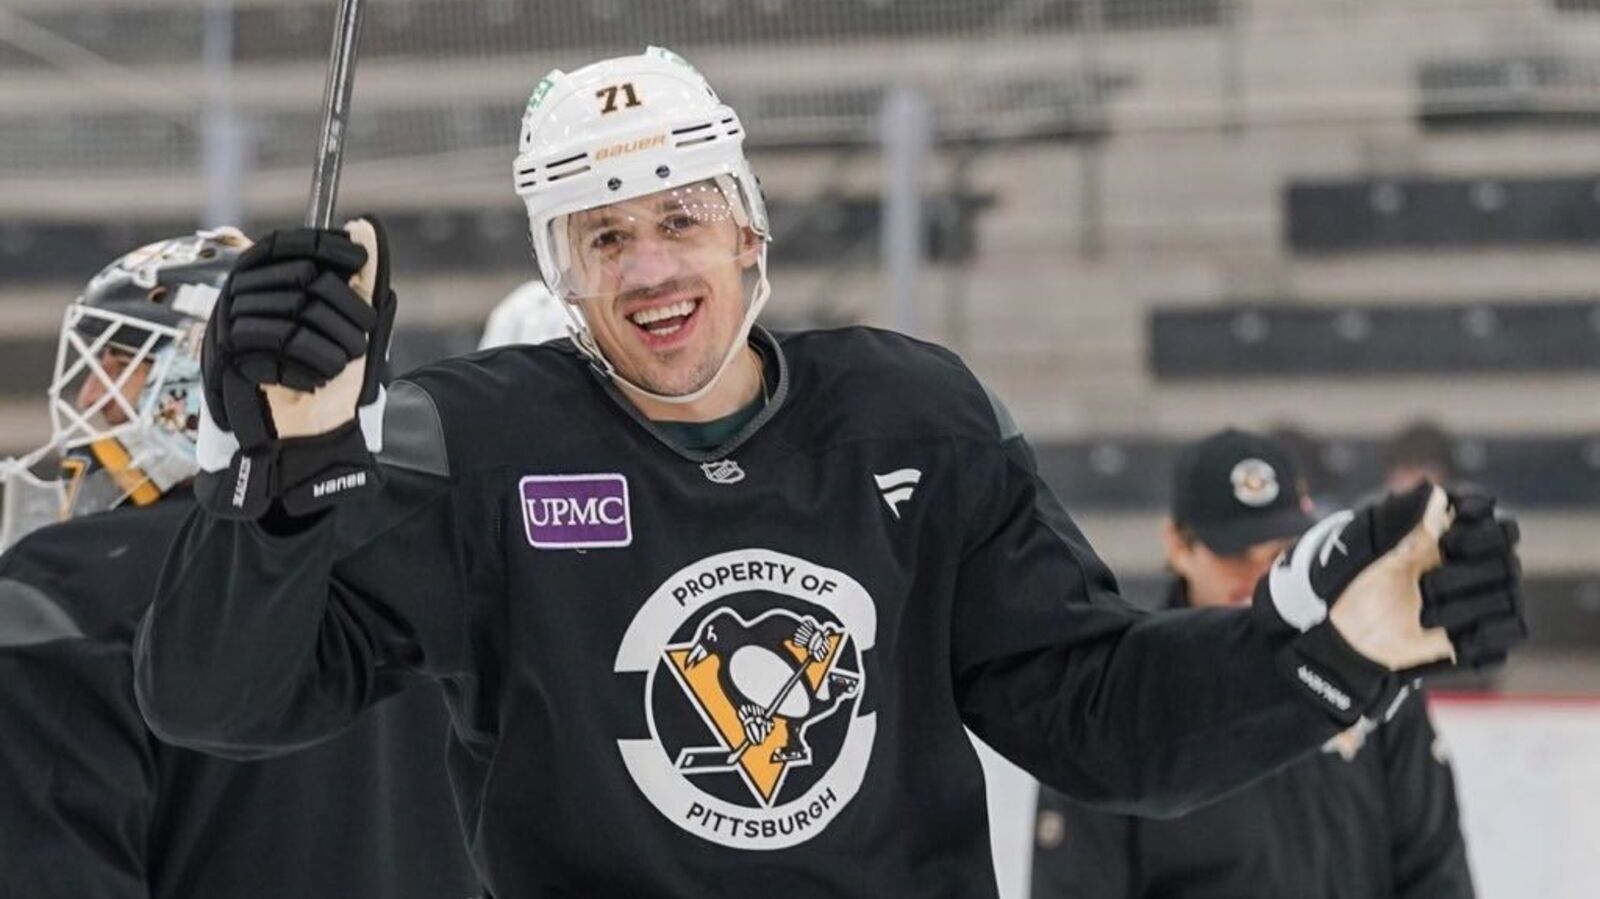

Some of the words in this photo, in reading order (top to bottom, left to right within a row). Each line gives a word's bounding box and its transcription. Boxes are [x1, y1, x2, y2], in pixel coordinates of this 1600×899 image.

[596, 83, 641, 114] 71
[527, 497, 625, 526] UPMC
[672, 561, 795, 607] PROPERTY
[801, 574, 837, 597] OF
[686, 787, 837, 838] PITTSBURGH
